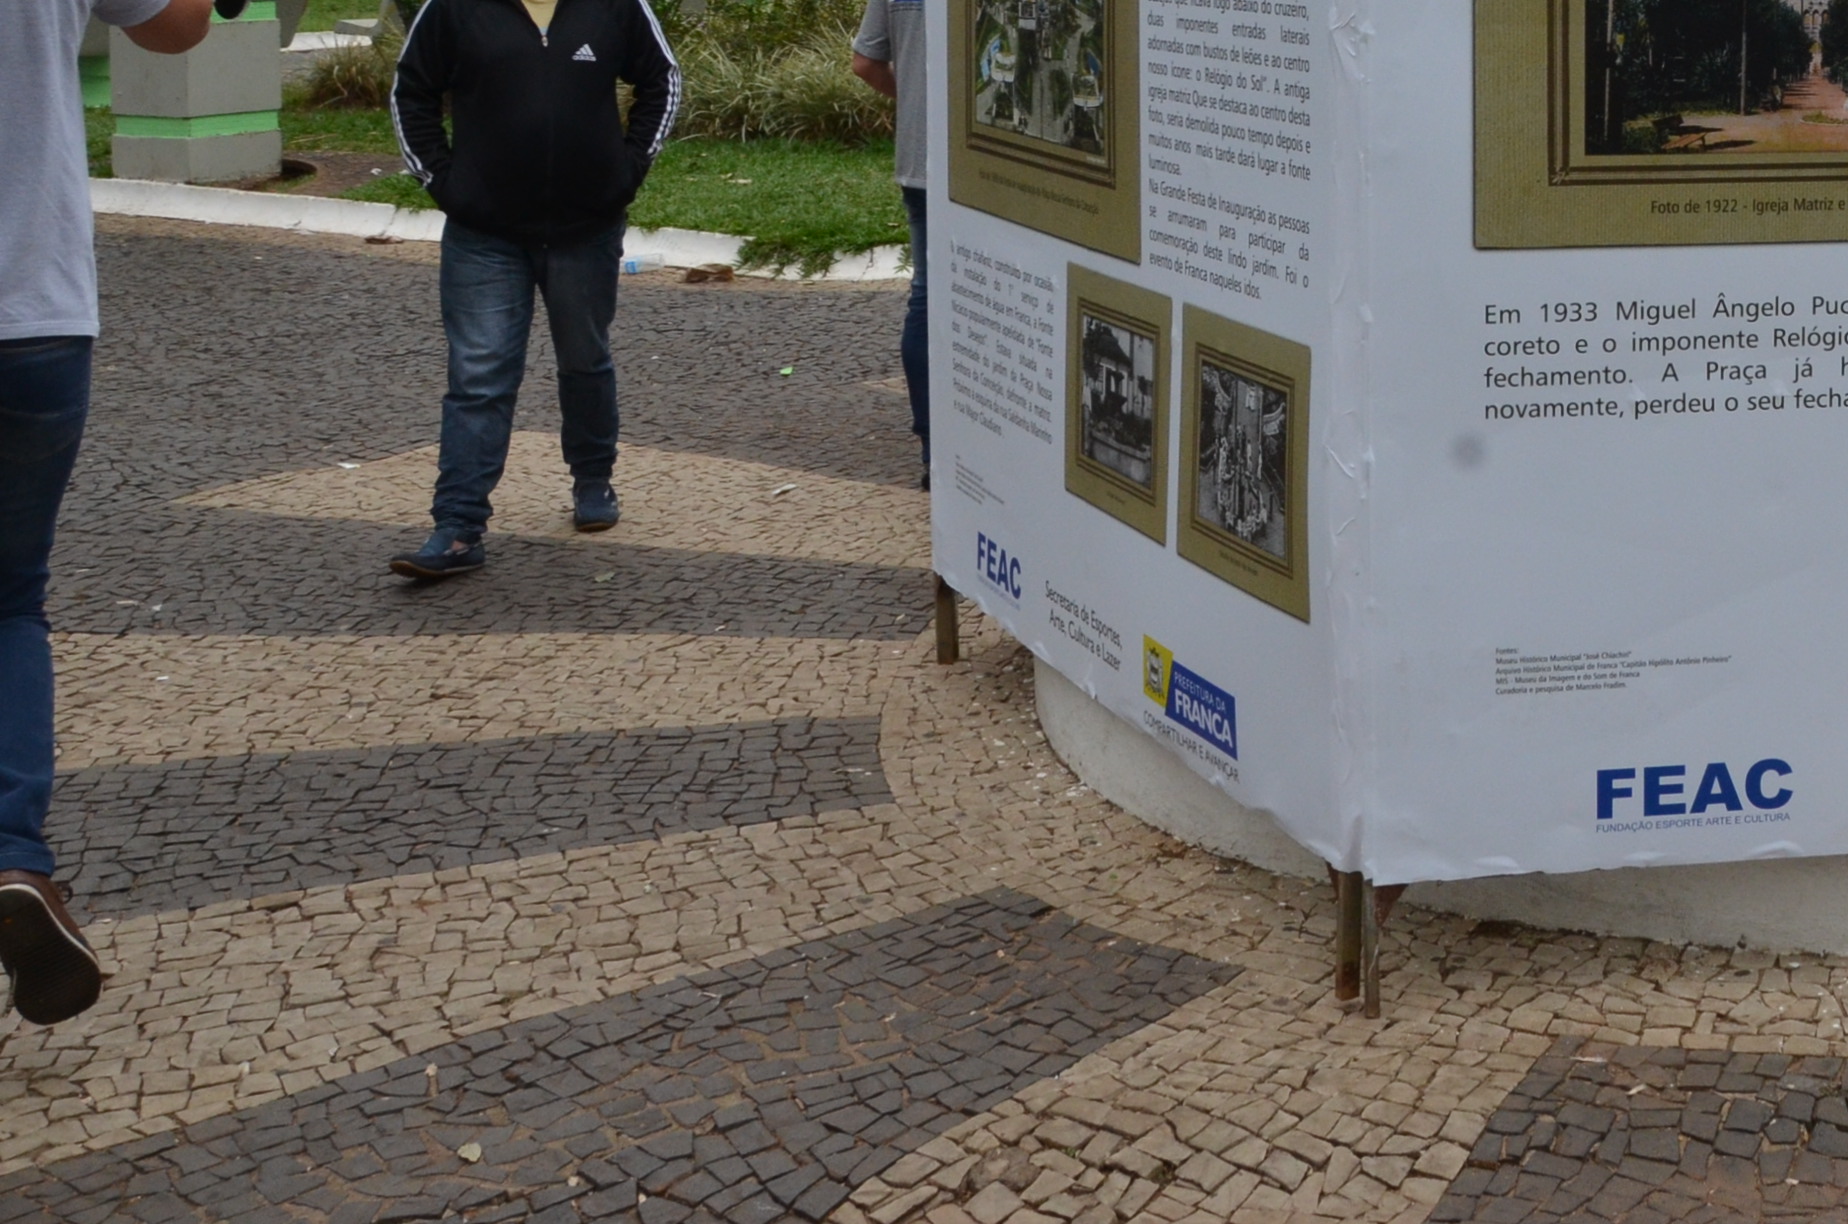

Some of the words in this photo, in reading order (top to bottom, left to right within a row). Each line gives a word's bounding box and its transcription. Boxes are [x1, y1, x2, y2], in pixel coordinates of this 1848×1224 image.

[1650, 199, 1681, 214] Foto
[1684, 197, 1702, 214] de
[1705, 197, 1739, 213] 1922
[1752, 196, 1790, 216] Igreja
[1793, 195, 1835, 211] Matriz
[1838, 199, 1847, 211] e
[1485, 303, 1522, 325] Em
[1540, 301, 1598, 323] 1933
[1616, 297, 1697, 326] Miguel
[1712, 291, 1796, 323] Ângelo
[1484, 335, 1561, 356] coreto
[1575, 338, 1589, 354] e
[1602, 337, 1618, 353] o
[1632, 329, 1760, 357] imponente
[1483, 365, 1634, 388] fechamento.
[1661, 361, 1680, 382] A
[1706, 360, 1768, 385] Praça
[1792, 356, 1814, 384] já
[1485, 397, 1625, 420] novamente,
[1634, 391, 1716, 420] perdeu
[1724, 396, 1740, 412] o
[1747, 394, 1786, 411] seu
[977, 531, 1021, 600] FEAC
[1045, 580, 1079, 616] Secretaria
[1081, 604, 1089, 622] de
[1091, 610, 1122, 650] Esportes,
[1050, 609, 1066, 637] Arte,
[1068, 619, 1094, 654] Cultura
[1096, 645, 1100, 658] e
[1102, 644, 1120, 671] Lazer
[1174, 671, 1214, 705] PREFEITURA
[1215, 693, 1226, 712] DA
[1175, 689, 1232, 749] FRANCA
[1597, 757, 1794, 820] FEAC
[1596, 822, 1652, 834] FUNDAÇÃO
[1656, 818, 1702, 829] ESPORTE
[1706, 816, 1731, 825] ARTE
[1734, 816, 1741, 824] E
[1744, 812, 1790, 824] CULTURA
